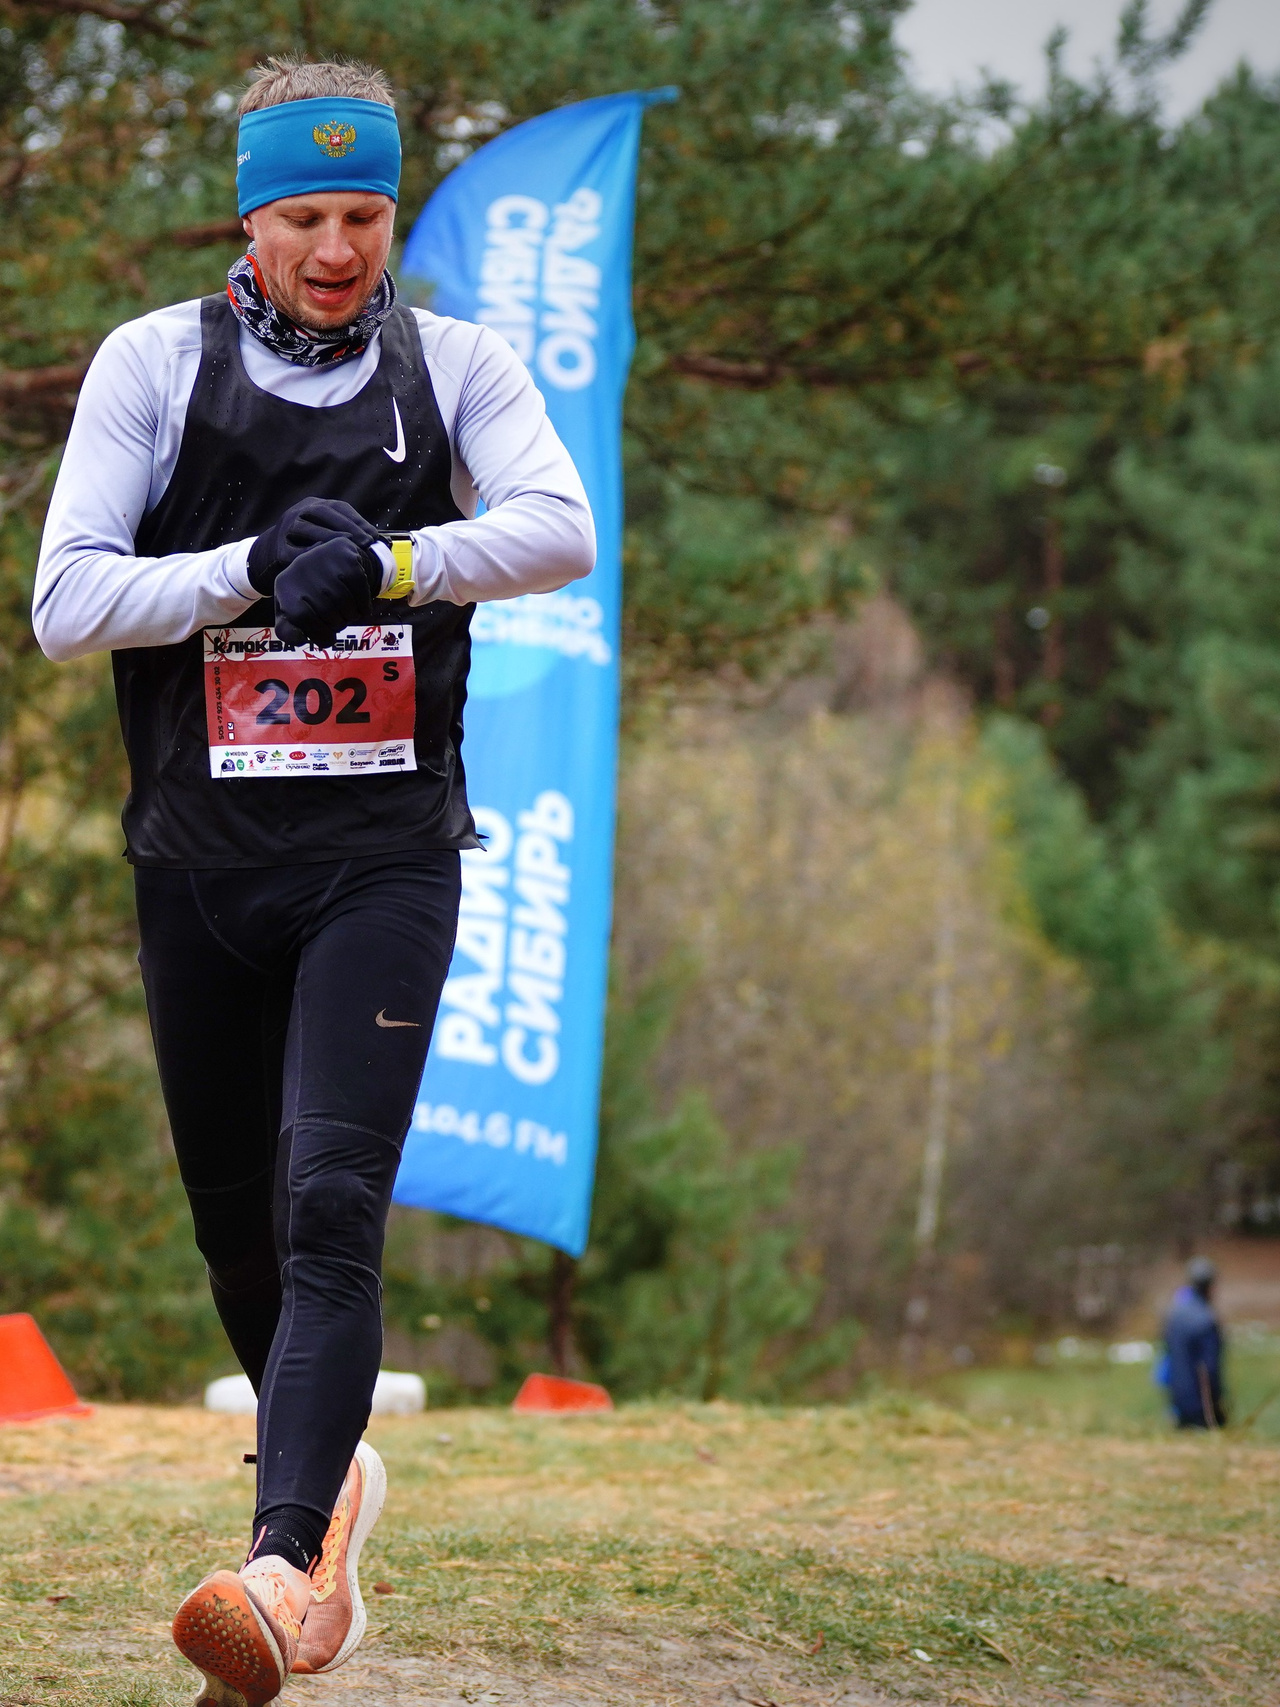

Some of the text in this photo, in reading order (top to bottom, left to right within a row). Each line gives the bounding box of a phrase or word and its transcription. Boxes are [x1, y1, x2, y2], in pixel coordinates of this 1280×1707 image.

[474, 194, 548, 372] СИБИР
[382, 661, 400, 681] S
[254, 677, 371, 726] 202
[217, 725, 225, 740] SOS
[501, 788, 576, 1087] СИБИРЬ
